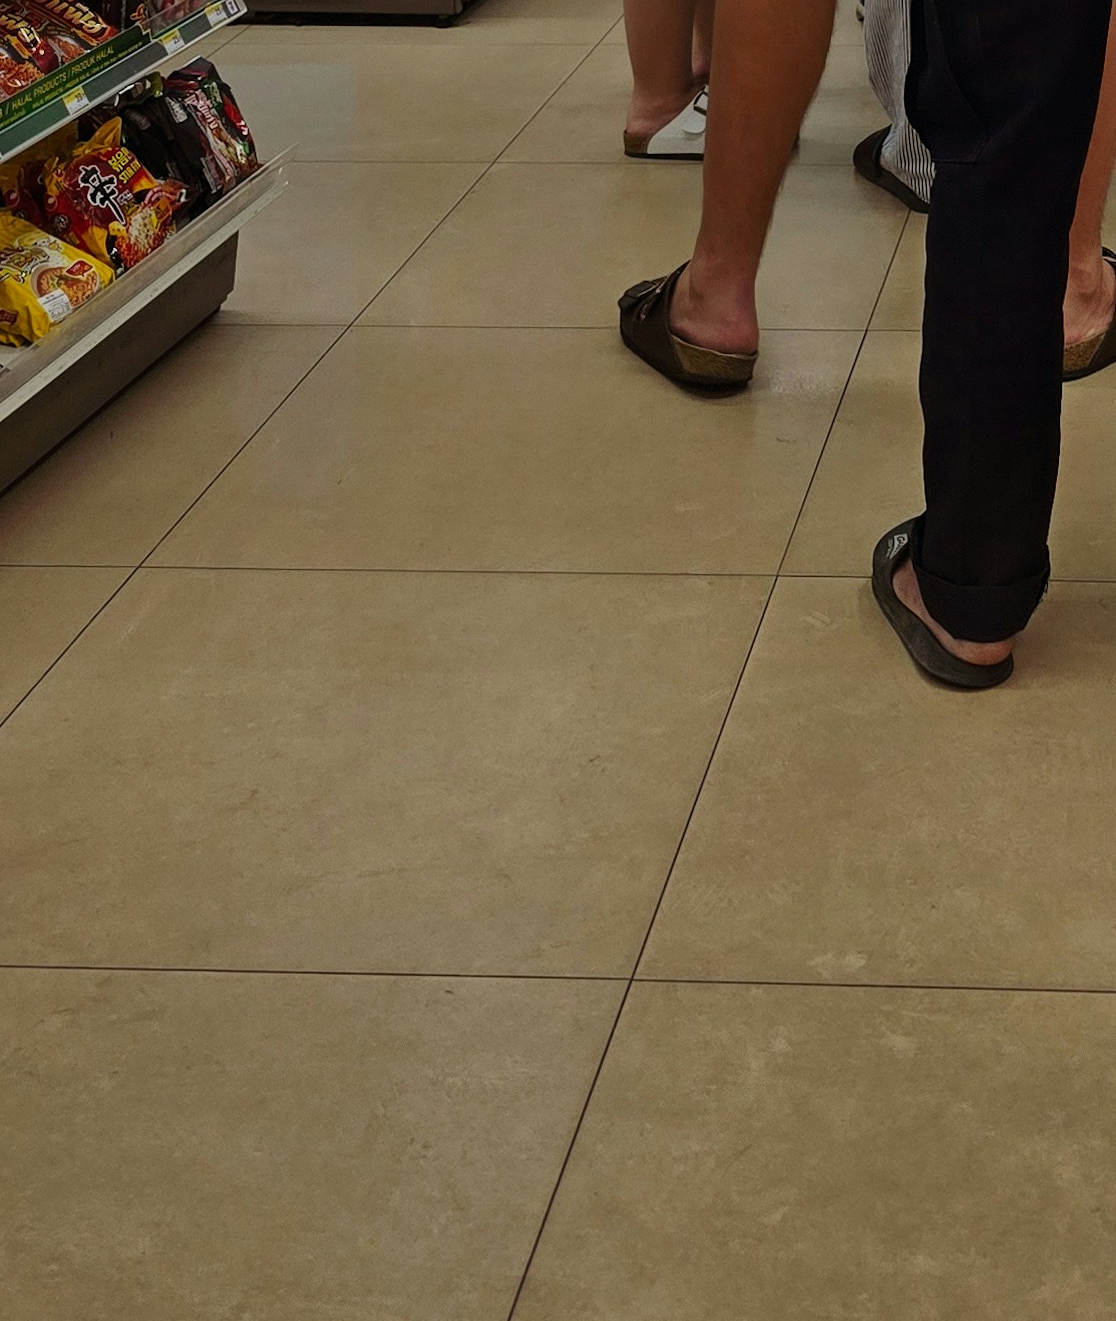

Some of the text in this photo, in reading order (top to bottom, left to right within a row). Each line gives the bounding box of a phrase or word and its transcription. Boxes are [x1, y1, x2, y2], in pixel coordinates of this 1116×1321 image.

[11, 92, 33, 111] HALAL
[33, 72, 67, 98] PRODUCTS
[71, 56, 96, 77] PRODUK
[95, 46, 115, 64] HALAL
